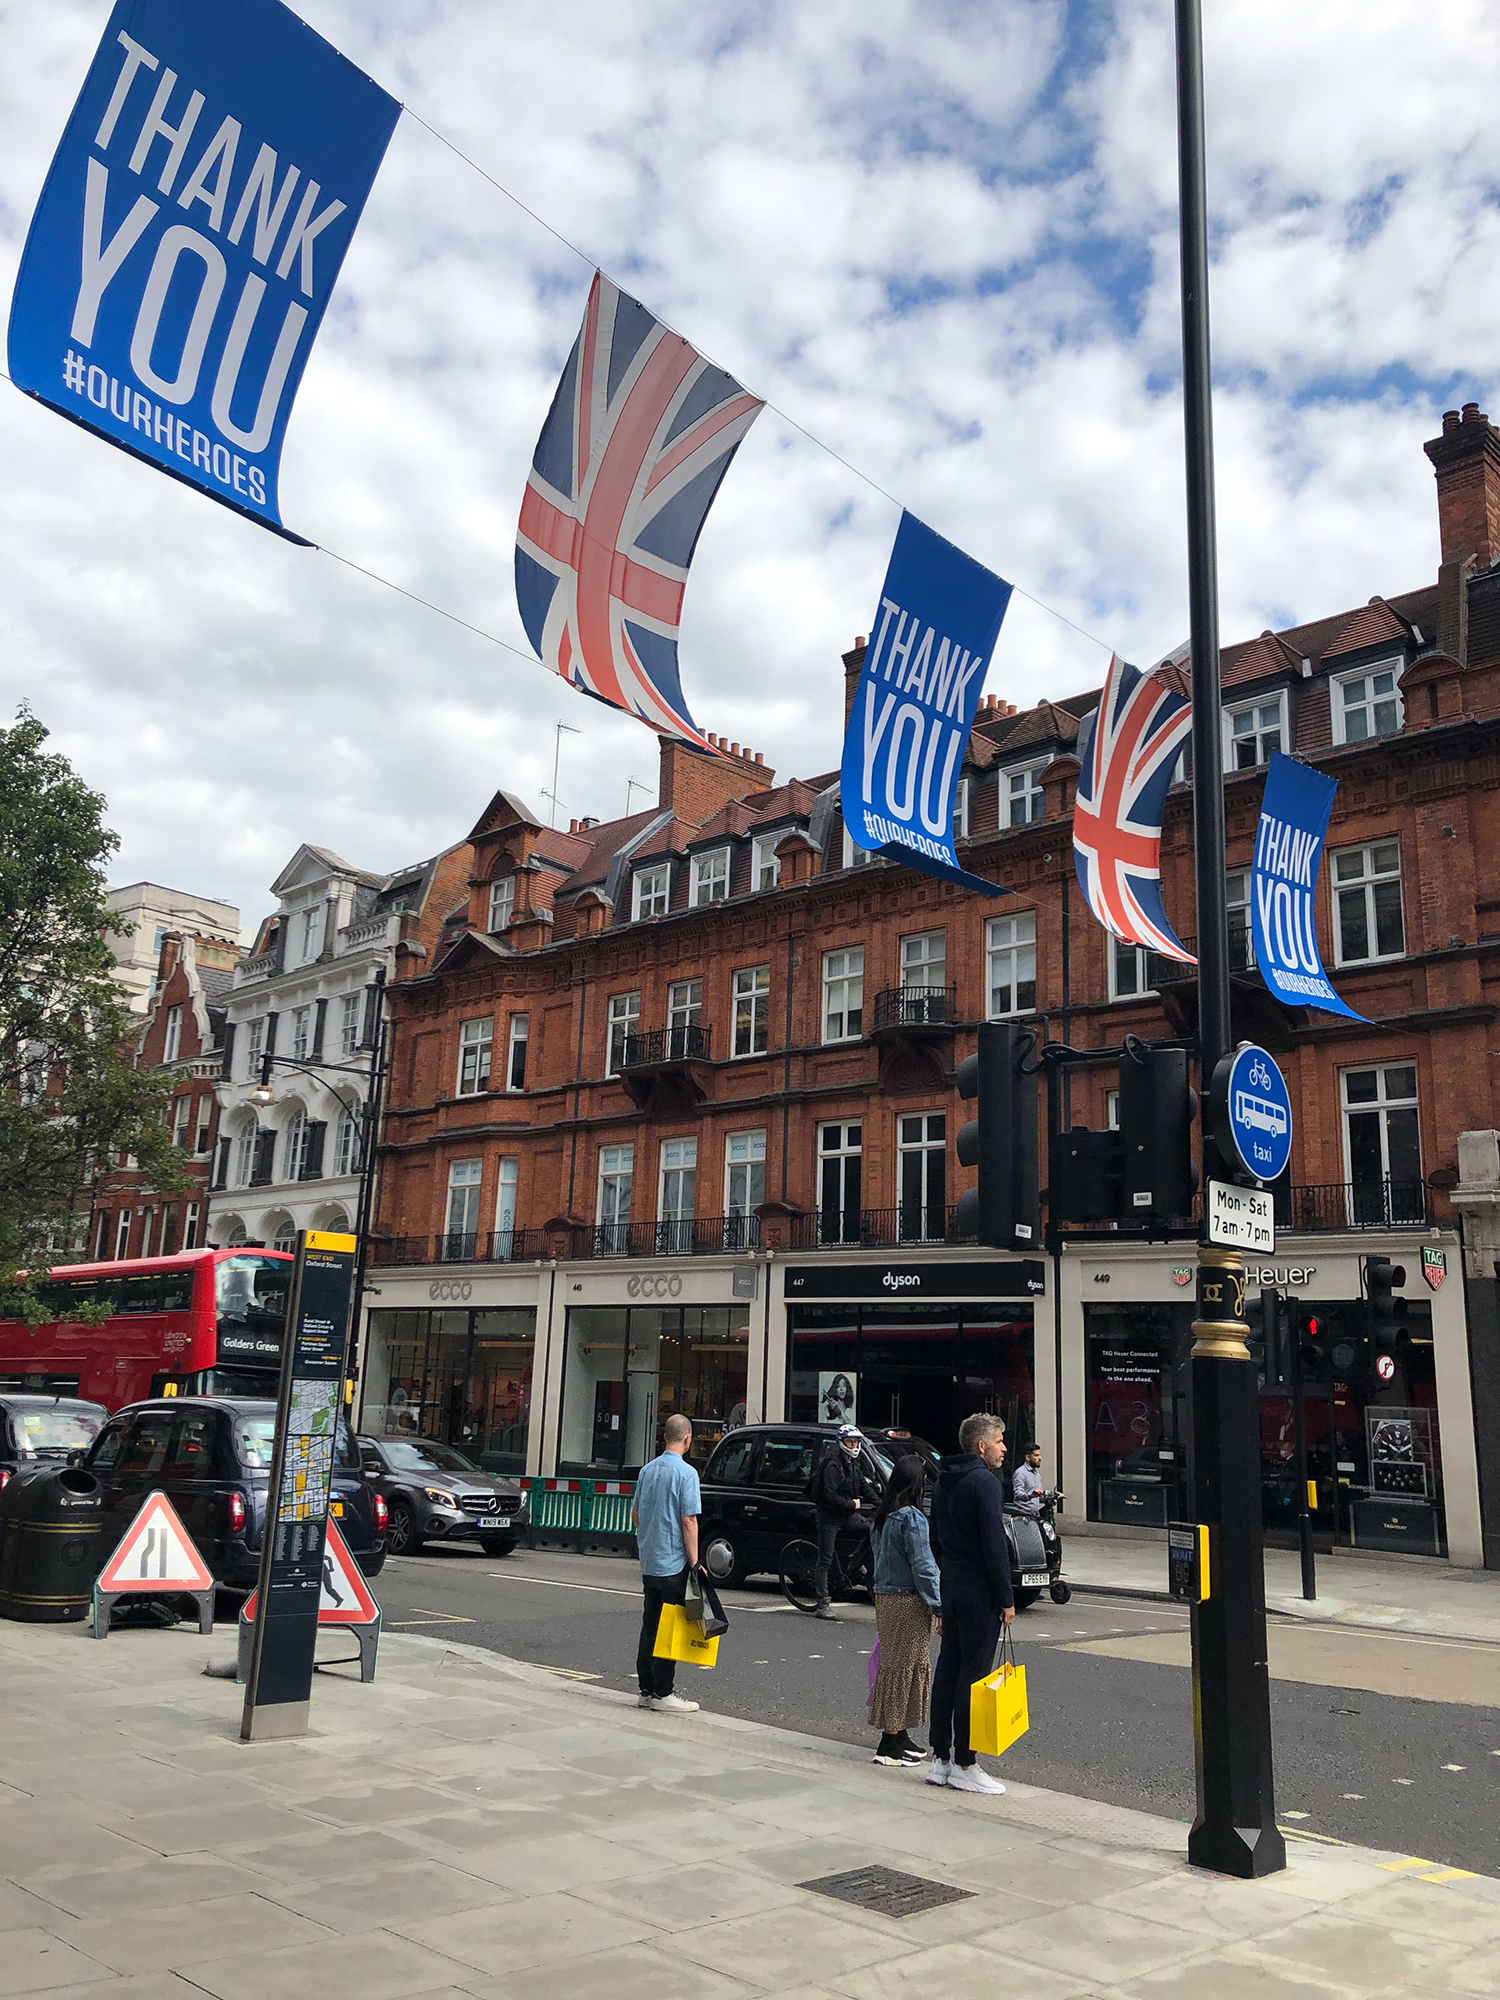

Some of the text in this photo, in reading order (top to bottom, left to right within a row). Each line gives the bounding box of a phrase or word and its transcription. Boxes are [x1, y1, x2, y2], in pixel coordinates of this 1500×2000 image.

[94, 29, 348, 299] THANK
[70, 155, 309, 453] YOU
[62, 349, 267, 505] #OURHEROES
[870, 596, 983, 725] THANK
[862, 680, 962, 837] YOU
[1257, 812, 1320, 888] THANK
[1257, 873, 1319, 975] YOU
[1271, 968, 1335, 1000] #OURHEROES
[1253, 1141, 1272, 1163] taxi
[1217, 1189, 1241, 1211] Mon
[1249, 1197, 1268, 1217] Sat
[1425, 1250, 1442, 1265] TAG
[627, 1273, 683, 1298] ecco
[793, 1278, 804, 1286] 447
[882, 1272, 920, 1290] dyson
[1027, 1279, 1044, 1290] dyson
[1093, 1274, 1110, 1284] 449
[1244, 1266, 1316, 1285] Heuer
[429, 1280, 473, 1300] ecco
[223, 1337, 280, 1352] Golders Green
[1173, 1548, 1193, 1562] WAIT
